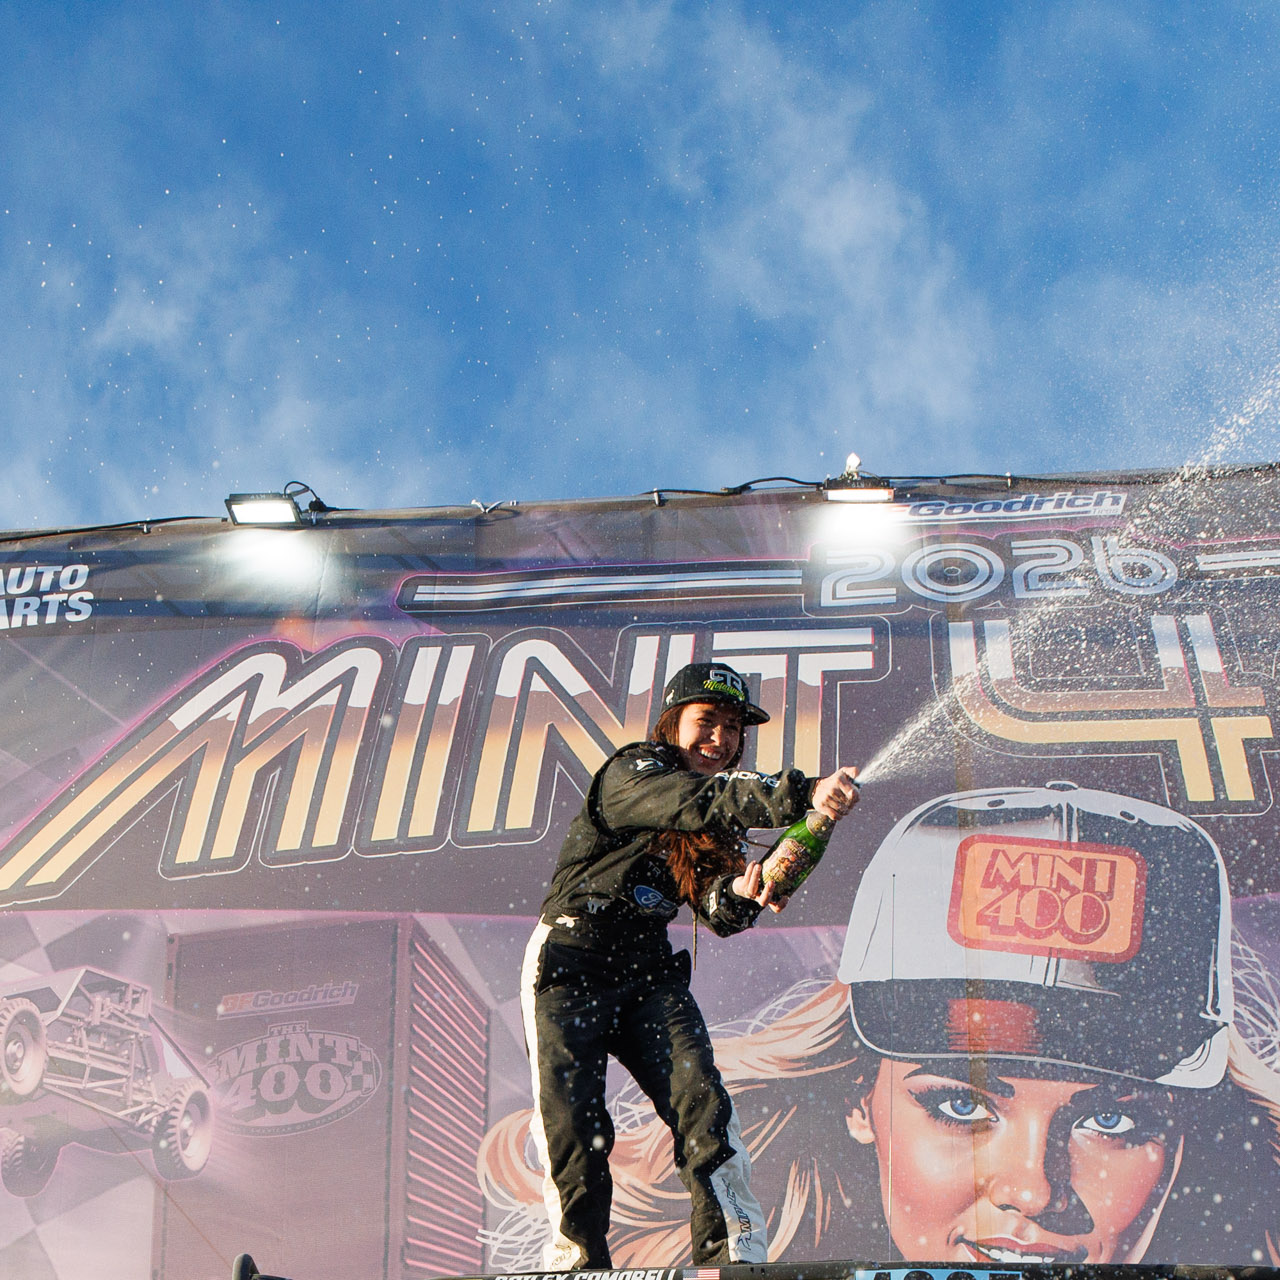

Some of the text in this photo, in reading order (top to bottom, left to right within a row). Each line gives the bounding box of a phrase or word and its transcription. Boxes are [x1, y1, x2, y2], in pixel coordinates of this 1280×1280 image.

[900, 490, 1122, 518] Goodrich
[976, 886, 1112, 944] 400
[270, 1024, 306, 1036] THE
[217, 1033, 361, 1082] MINT
[226, 1061, 347, 1113] 400
